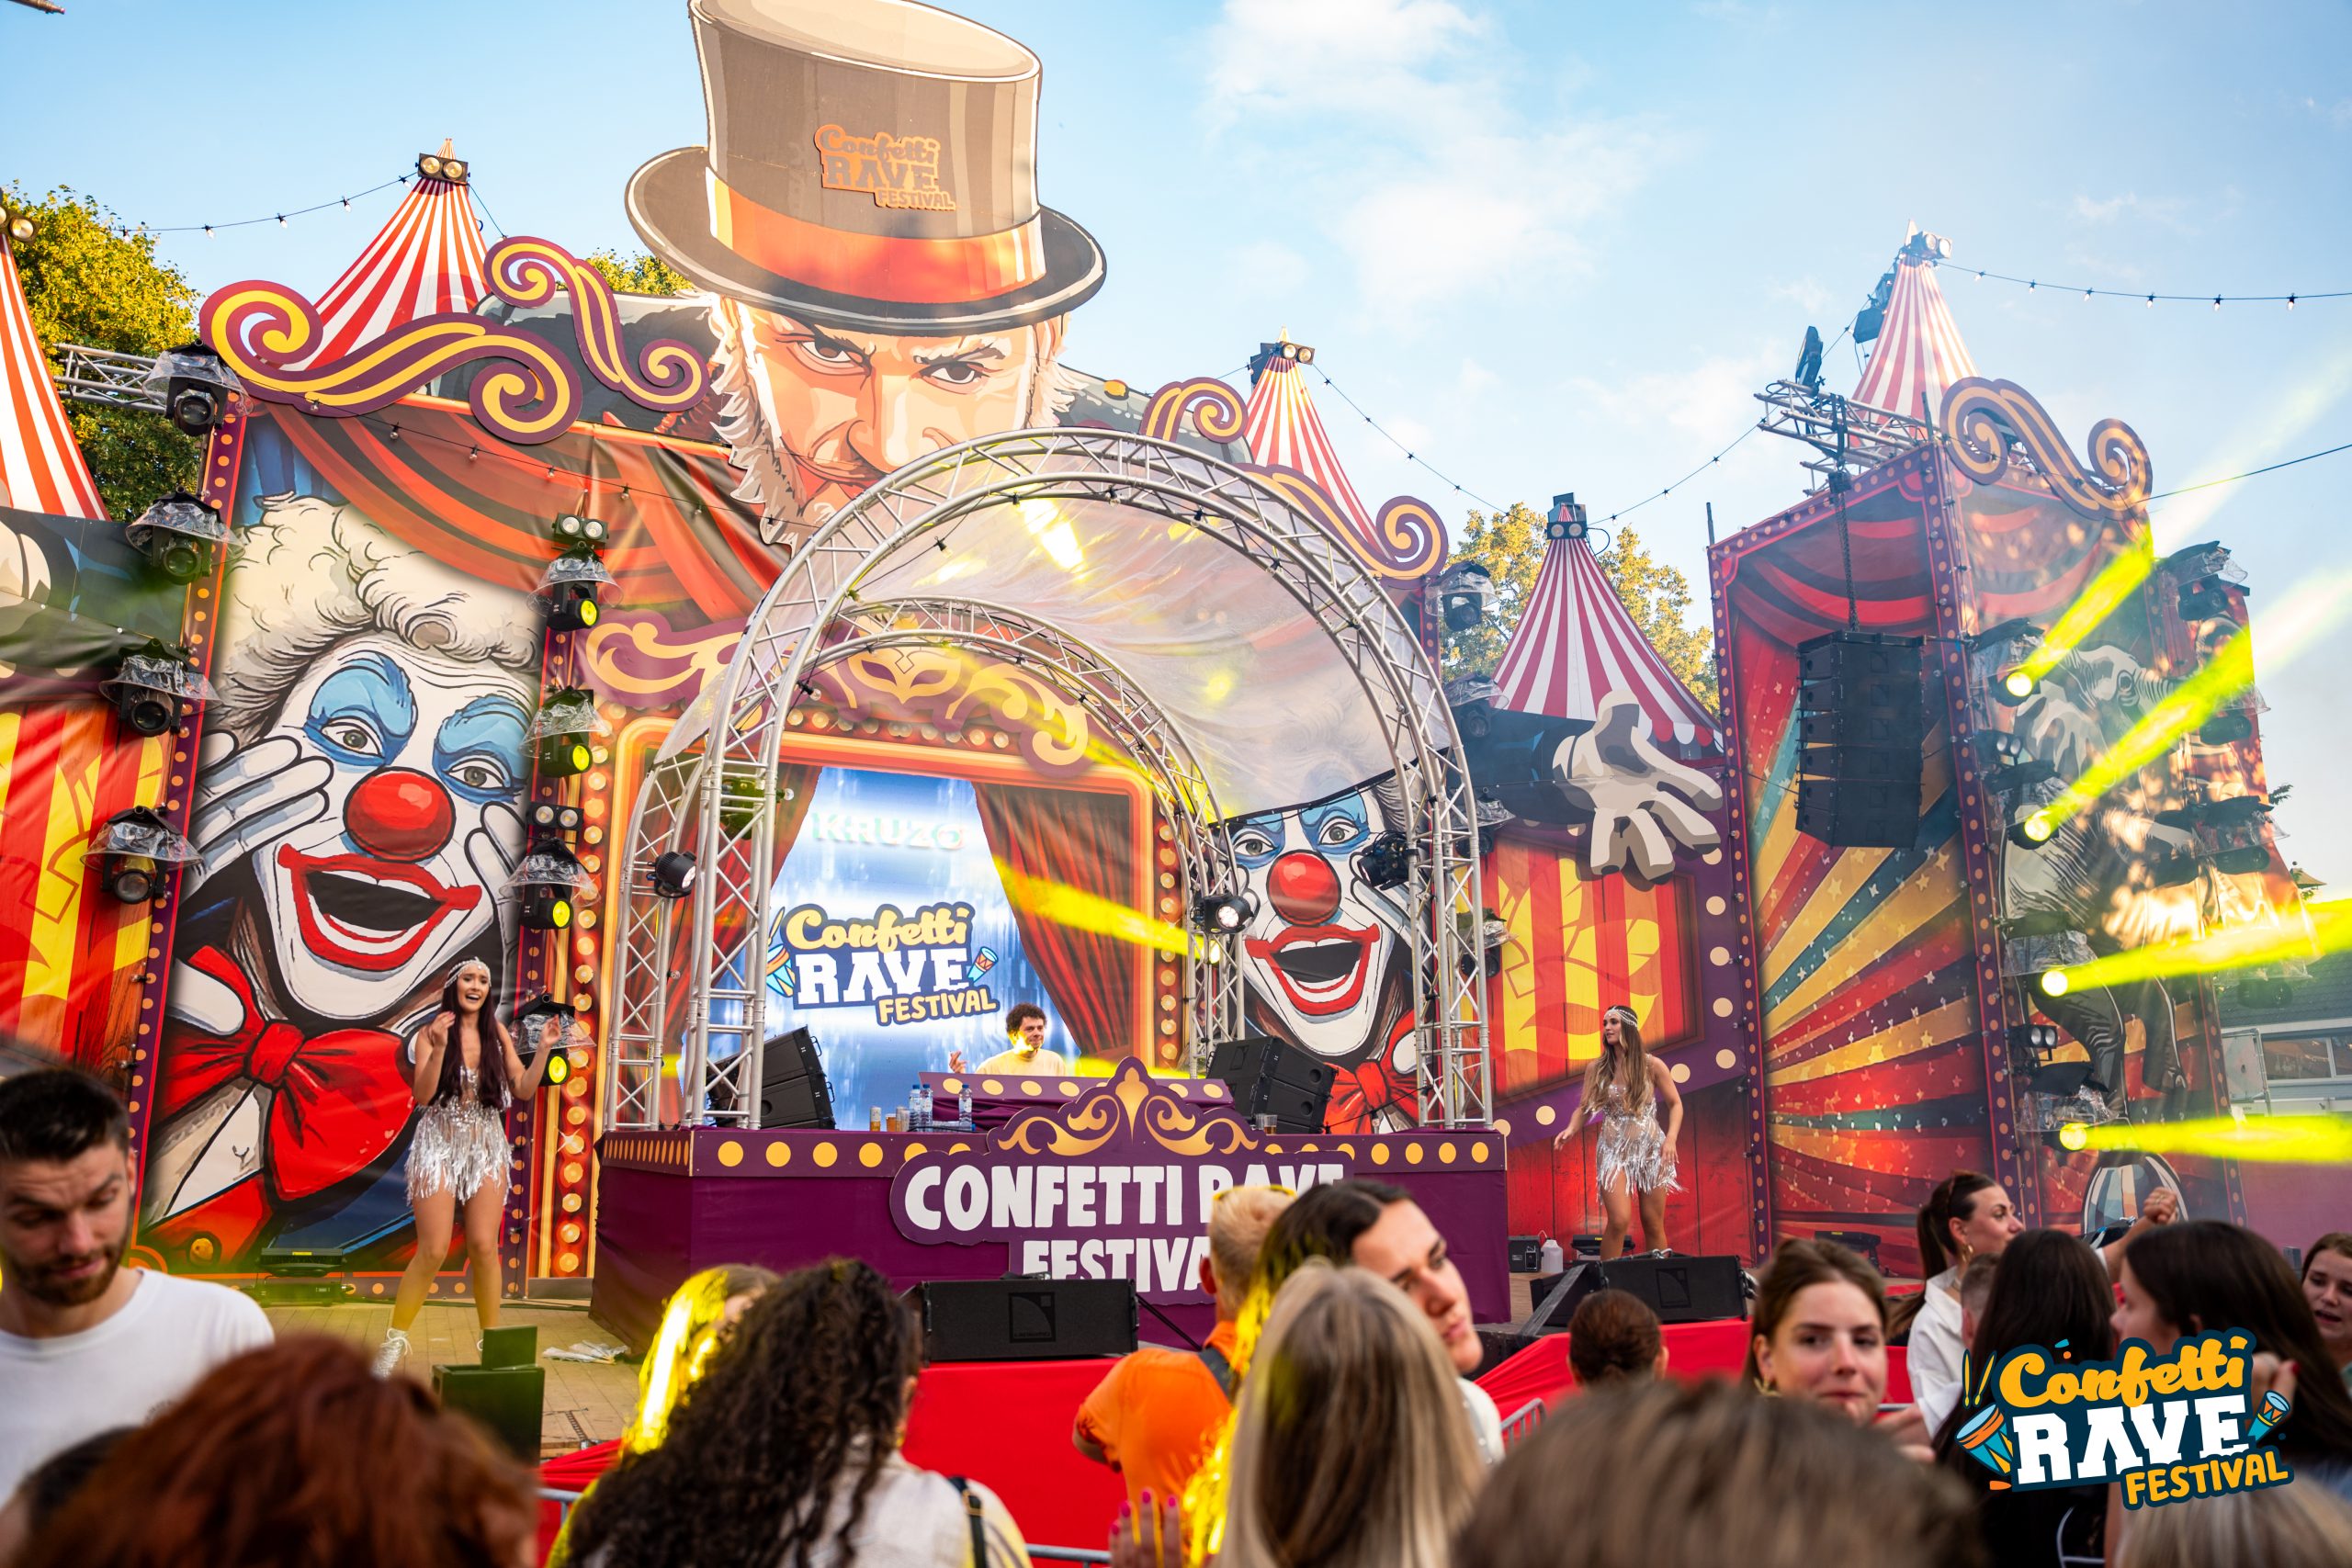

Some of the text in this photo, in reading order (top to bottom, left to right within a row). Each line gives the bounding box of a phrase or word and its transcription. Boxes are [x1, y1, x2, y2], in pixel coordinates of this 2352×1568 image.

[820, 129, 938, 164] Confetti
[827, 155, 935, 191] RAVE
[877, 191, 955, 208] FESTIVAL
[786, 907, 970, 953] Confetti
[796, 948, 969, 1005] RAVE
[877, 988, 997, 1023] FESTIVAL
[904, 1164, 1182, 1232] CONFETTI
